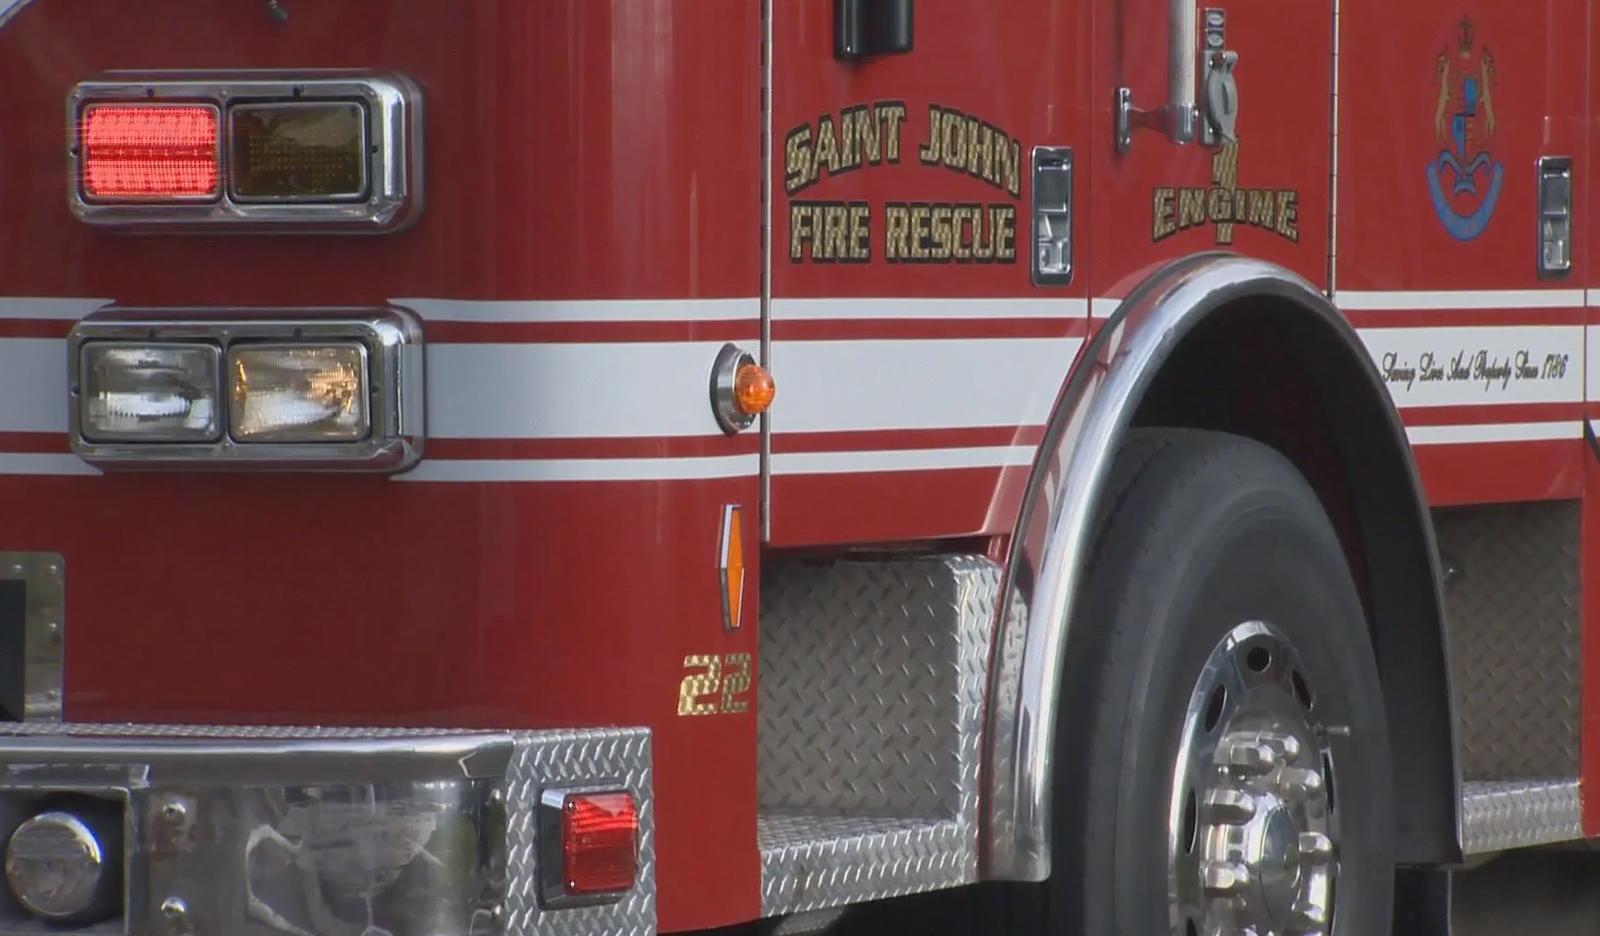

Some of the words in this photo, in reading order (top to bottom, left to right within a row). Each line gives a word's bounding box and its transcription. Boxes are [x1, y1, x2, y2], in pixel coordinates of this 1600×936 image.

[785, 100, 906, 196] SAINT
[919, 104, 1021, 200] JOHN
[789, 201, 870, 263] FIRE
[885, 202, 1016, 263] RESCUE
[1152, 187, 1299, 243] ENGINE
[1541, 353, 1569, 379] 1786
[677, 653, 751, 715] 22
